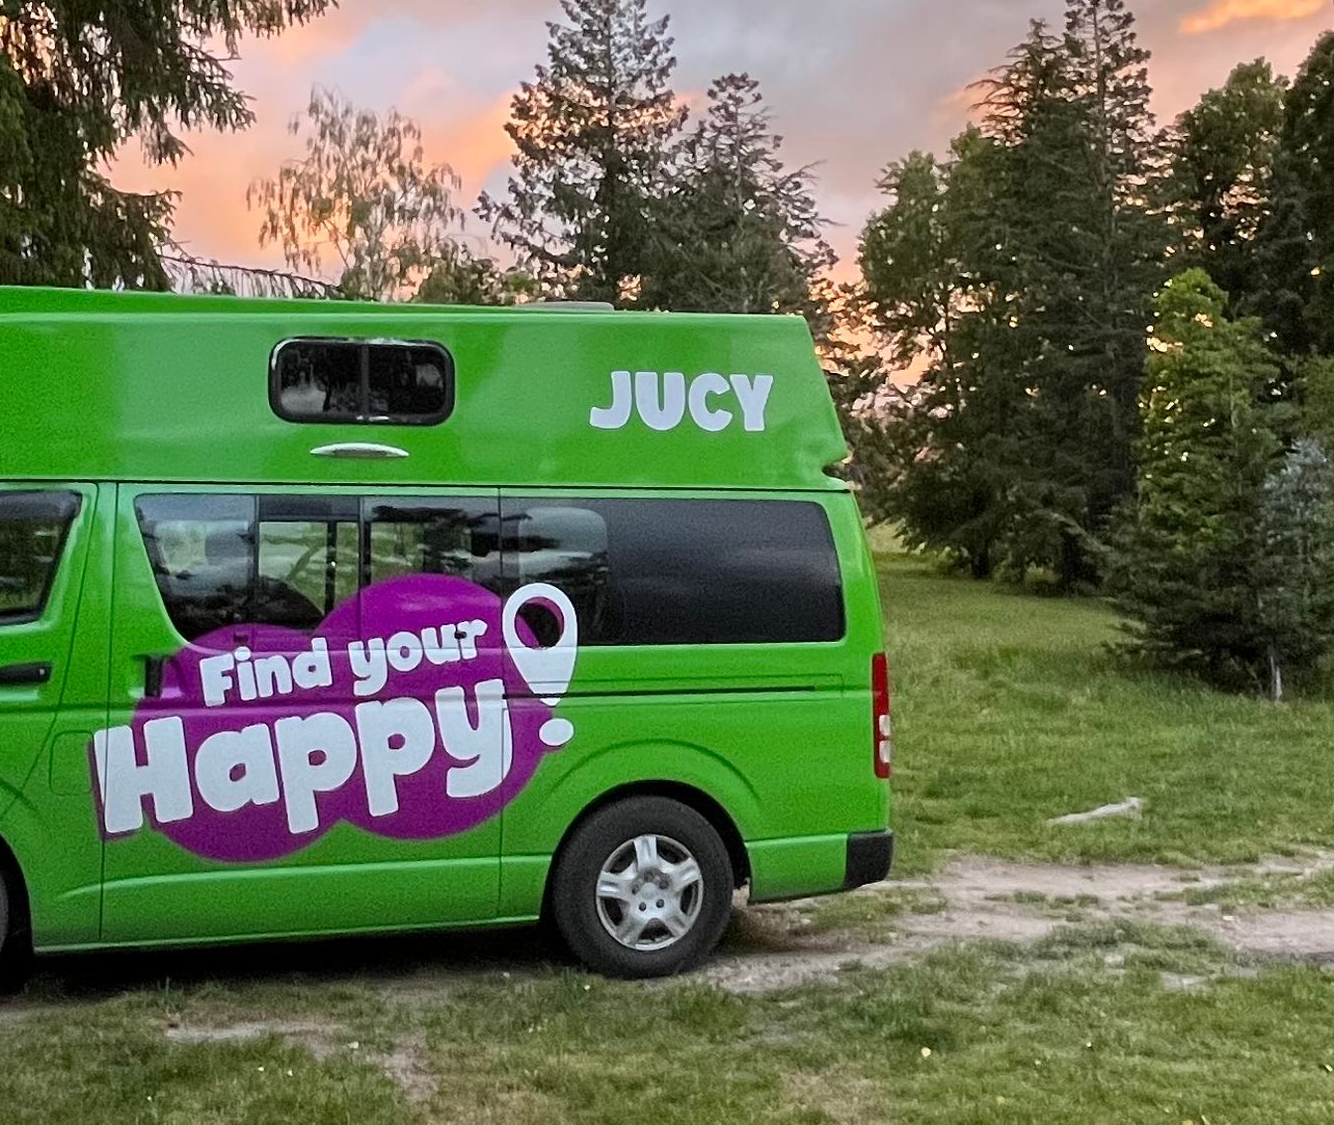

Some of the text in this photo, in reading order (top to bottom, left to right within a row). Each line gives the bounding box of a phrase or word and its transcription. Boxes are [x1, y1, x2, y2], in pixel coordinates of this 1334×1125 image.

[589, 371, 773, 431] JUCY
[199, 619, 487, 706] Find your
